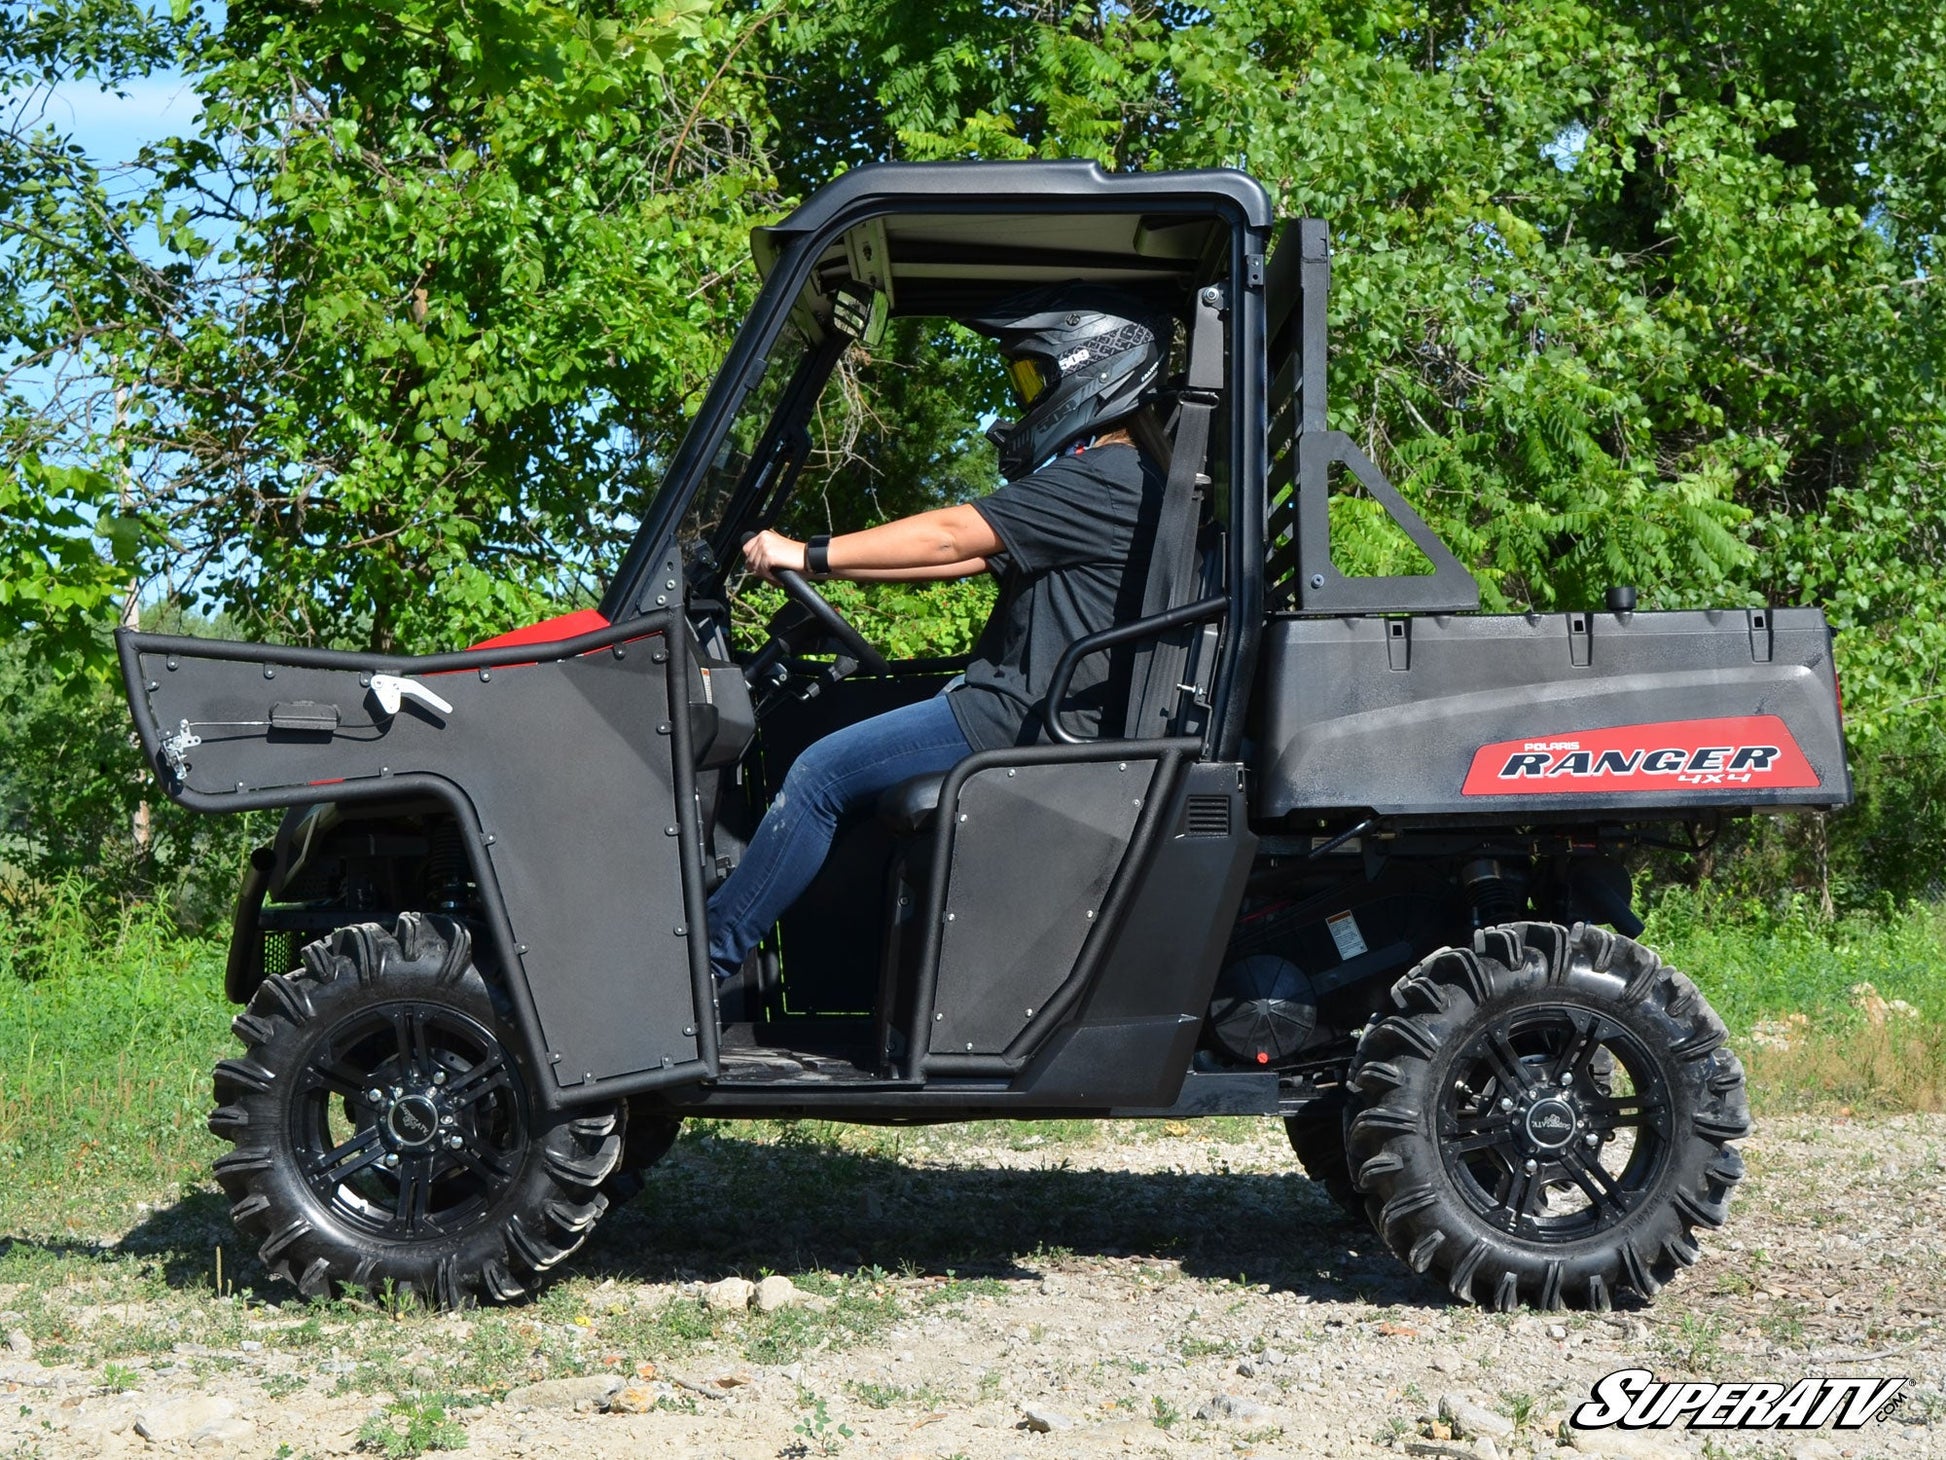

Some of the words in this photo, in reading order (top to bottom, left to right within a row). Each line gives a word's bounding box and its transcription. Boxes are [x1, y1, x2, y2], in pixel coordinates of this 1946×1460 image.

[1058, 349, 1090, 370] 509
[1524, 741, 1580, 751] POLARIS
[1497, 745, 1782, 779] RANGER
